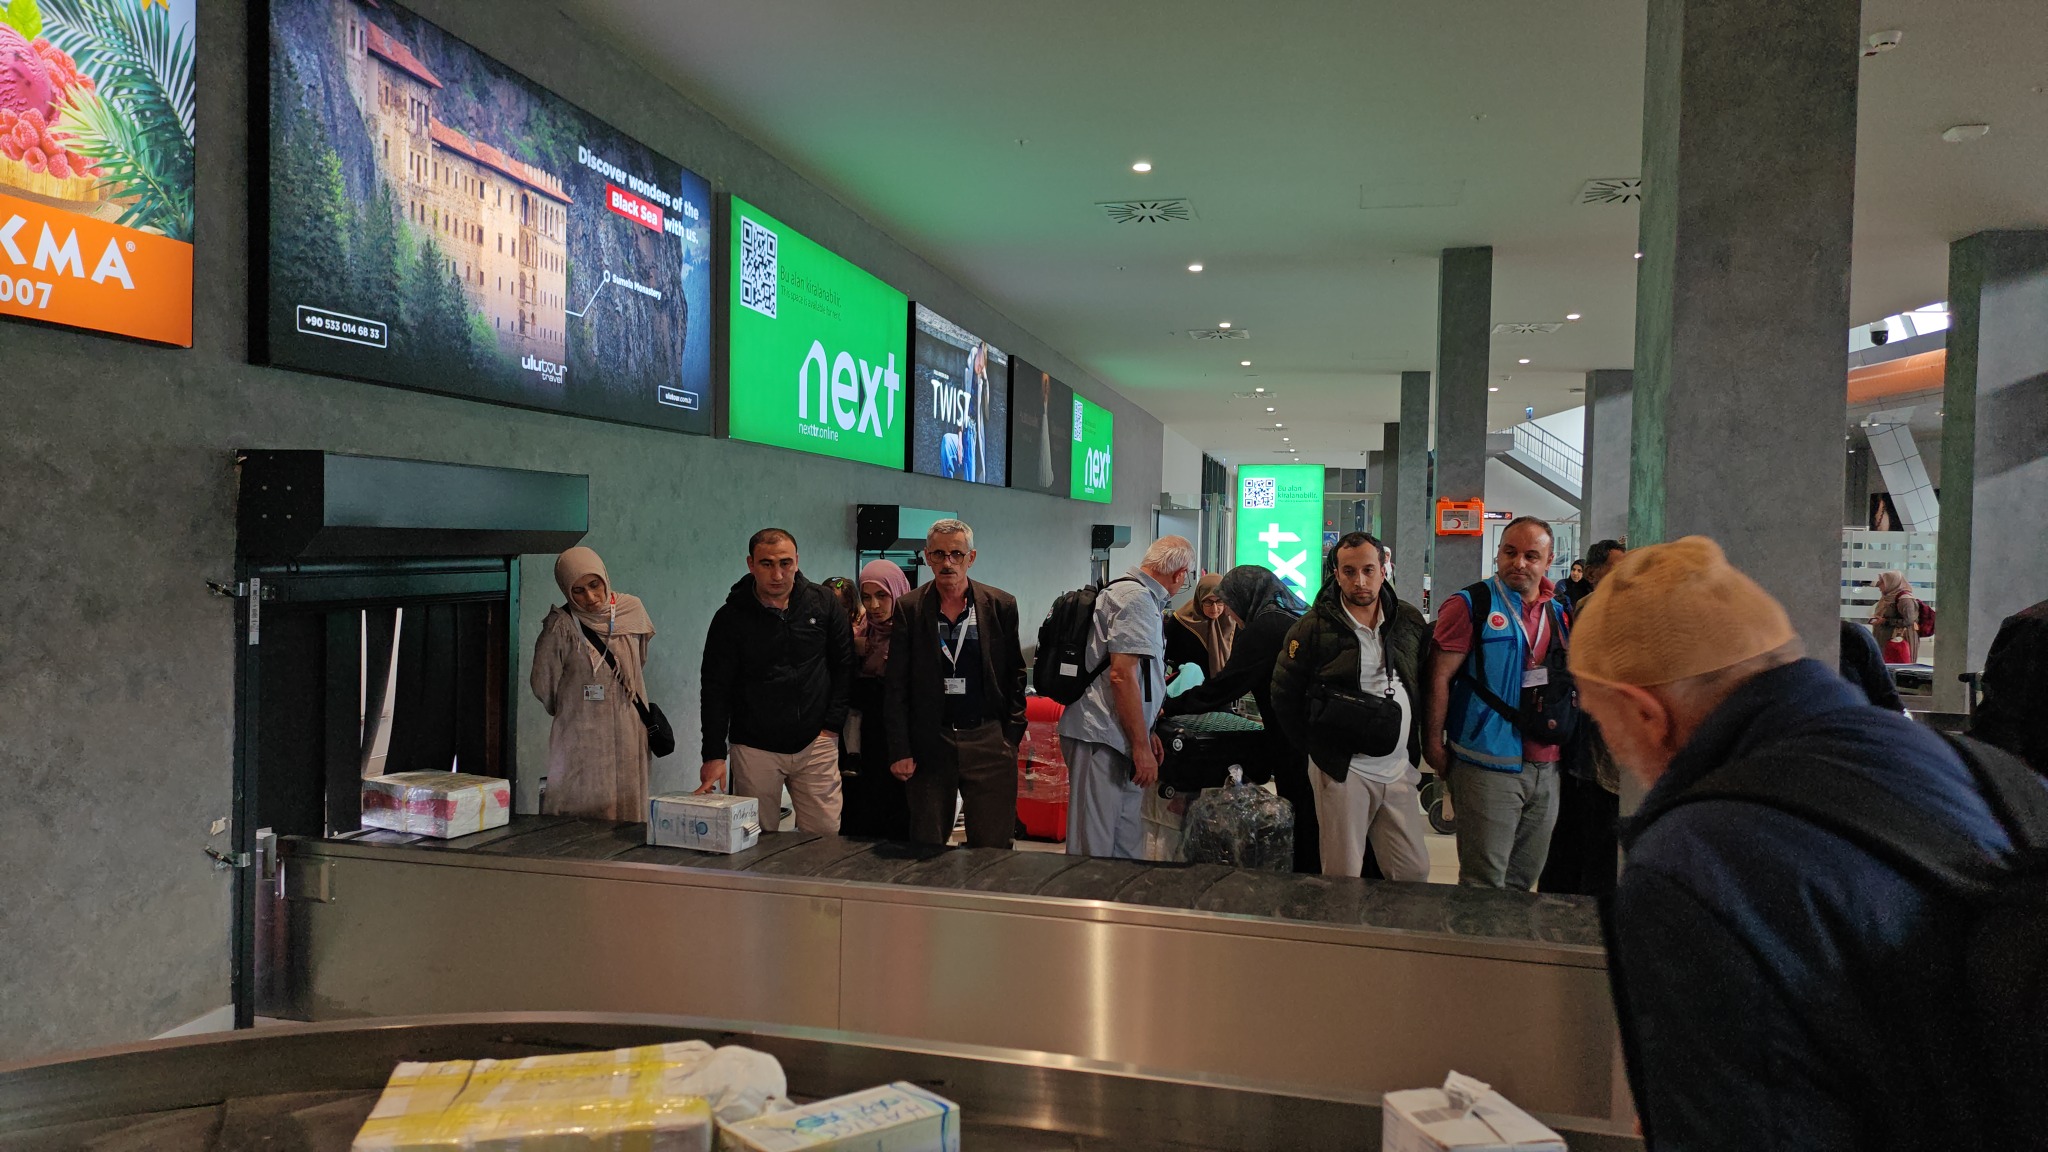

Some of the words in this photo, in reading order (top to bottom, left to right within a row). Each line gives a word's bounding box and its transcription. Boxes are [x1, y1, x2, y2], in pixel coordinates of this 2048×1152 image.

[578, 145, 628, 185] Discover
[628, 174, 671, 207] wonders
[672, 196, 683, 213] of
[683, 201, 699, 221] the
[611, 190, 640, 217] Black
[640, 205, 658, 226] Sea
[664, 217, 685, 238] with
[685, 228, 699, 244] us.
[0, 274, 53, 309] 007
[780, 265, 789, 283] Bu
[791, 271, 805, 290] alan
[305, 316, 323, 327] +90
[324, 319, 341, 331] 533
[342, 323, 356, 334] 014
[357, 325, 369, 337] 68
[369, 328, 380, 339] 33
[541, 372, 563, 384] travel
[798, 339, 900, 438] next
[930, 379, 972, 429] TWIST
[798, 423, 839, 441] nexttr.online
[1084, 444, 1111, 490] next
[1287, 484, 1302, 492] alan
